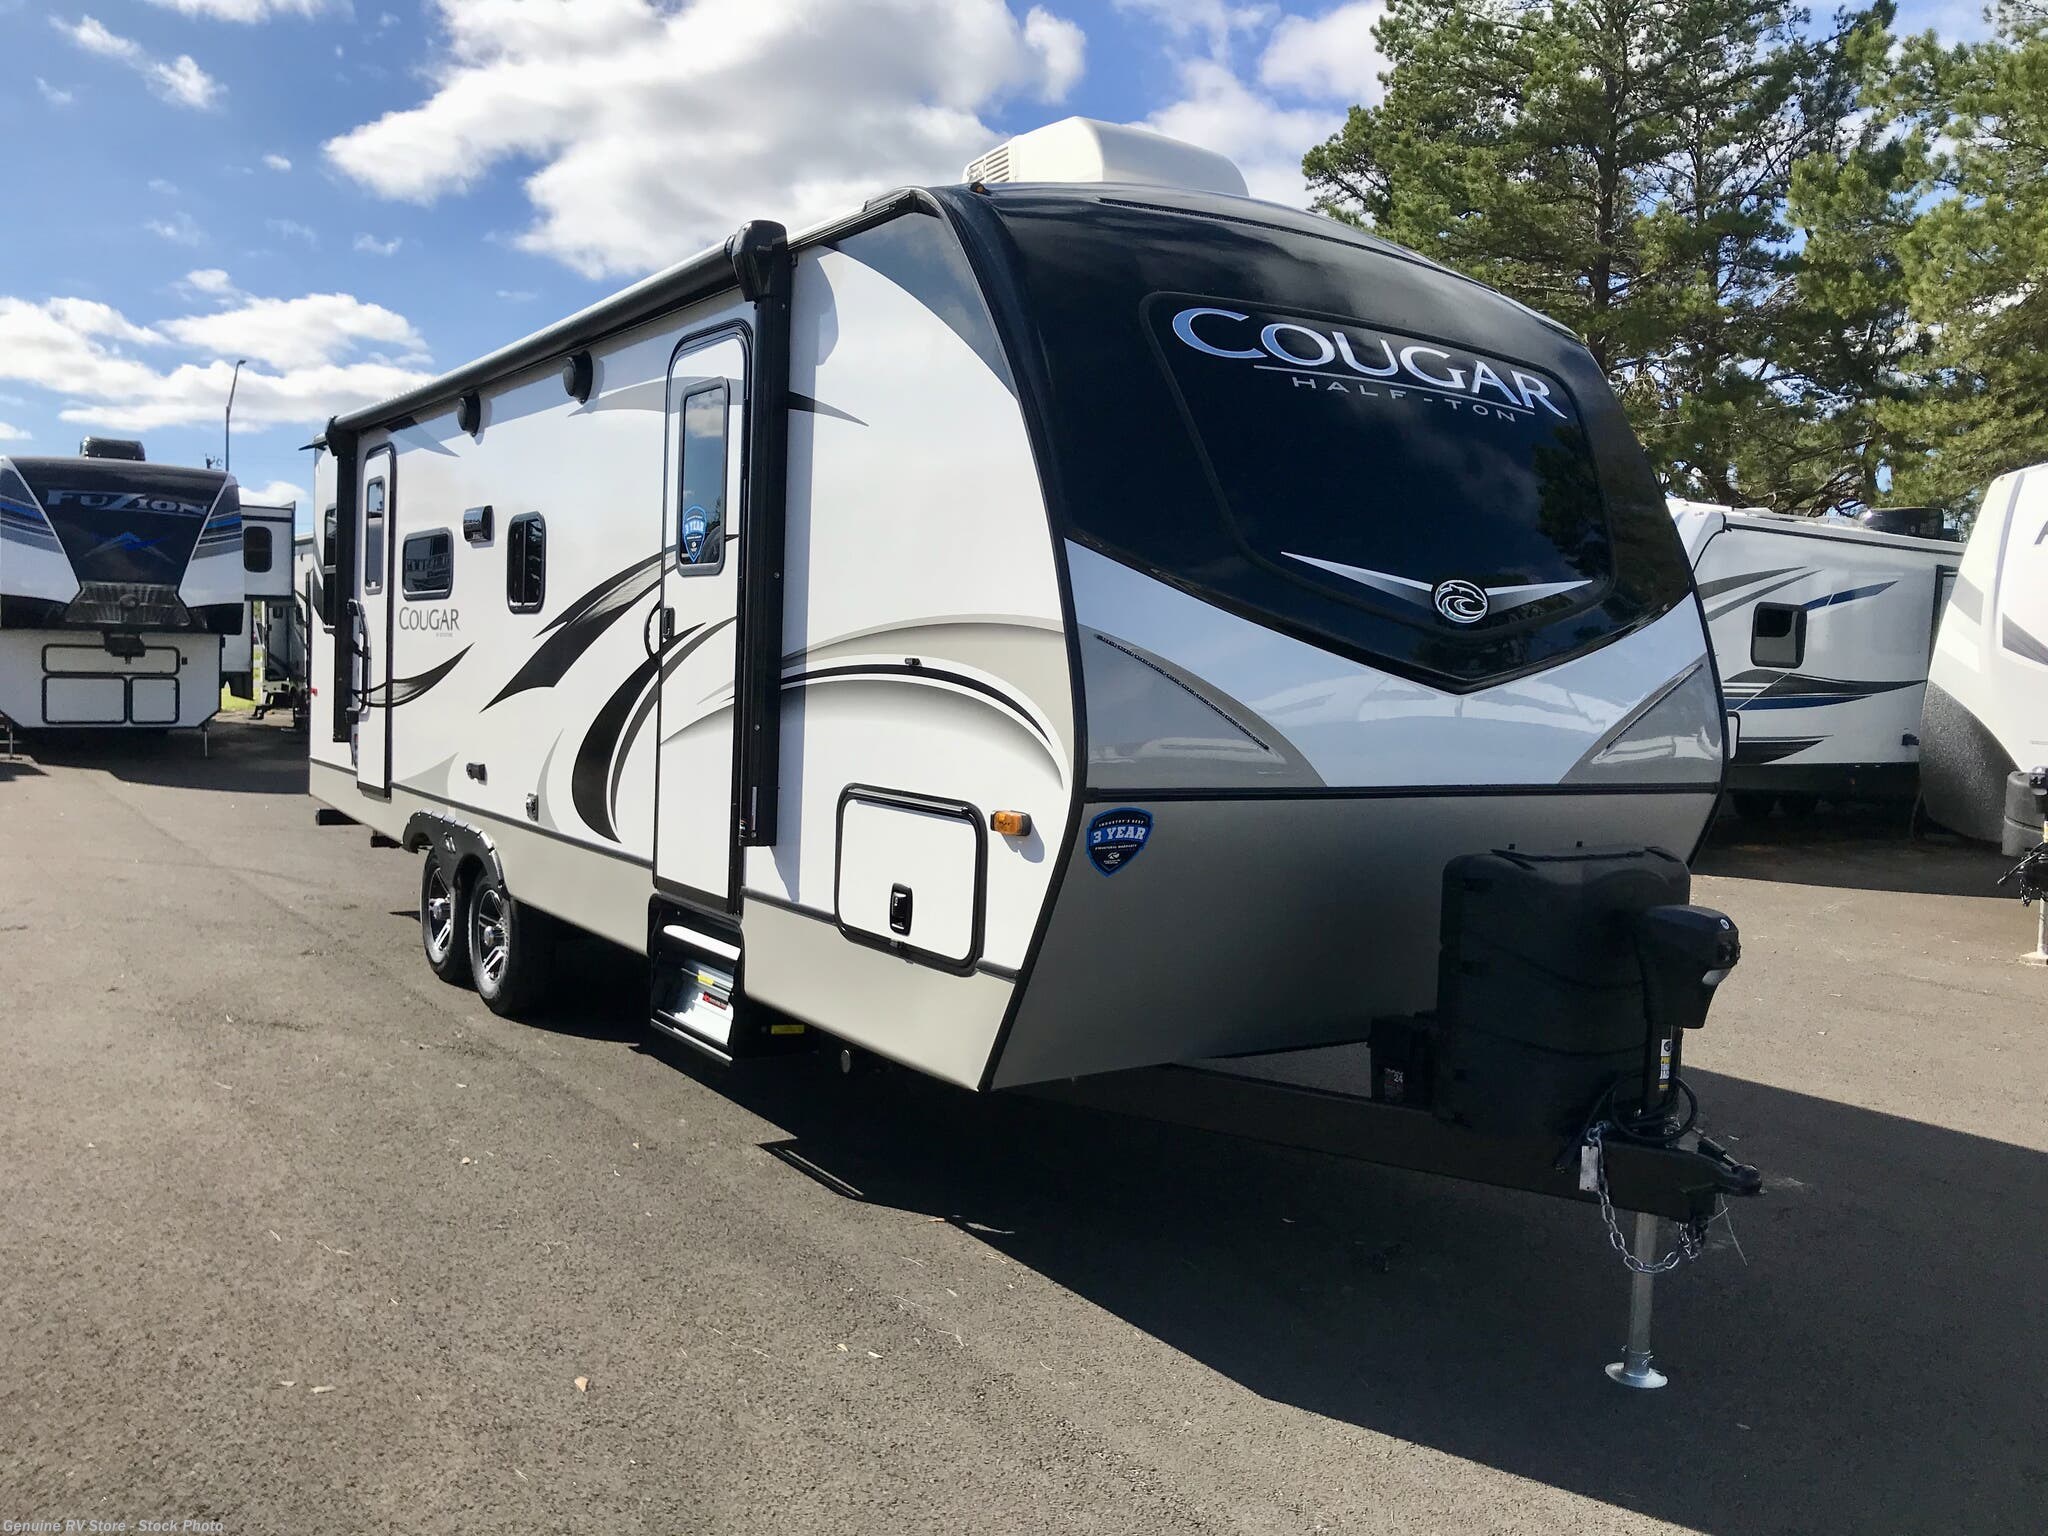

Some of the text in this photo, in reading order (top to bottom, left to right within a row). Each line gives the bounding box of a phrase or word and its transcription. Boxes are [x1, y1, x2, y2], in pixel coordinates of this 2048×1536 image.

[1172, 307, 1568, 420] COUGAR
[399, 606, 461, 631] COUGAR
[1093, 826, 1146, 843] 3 YEAR
